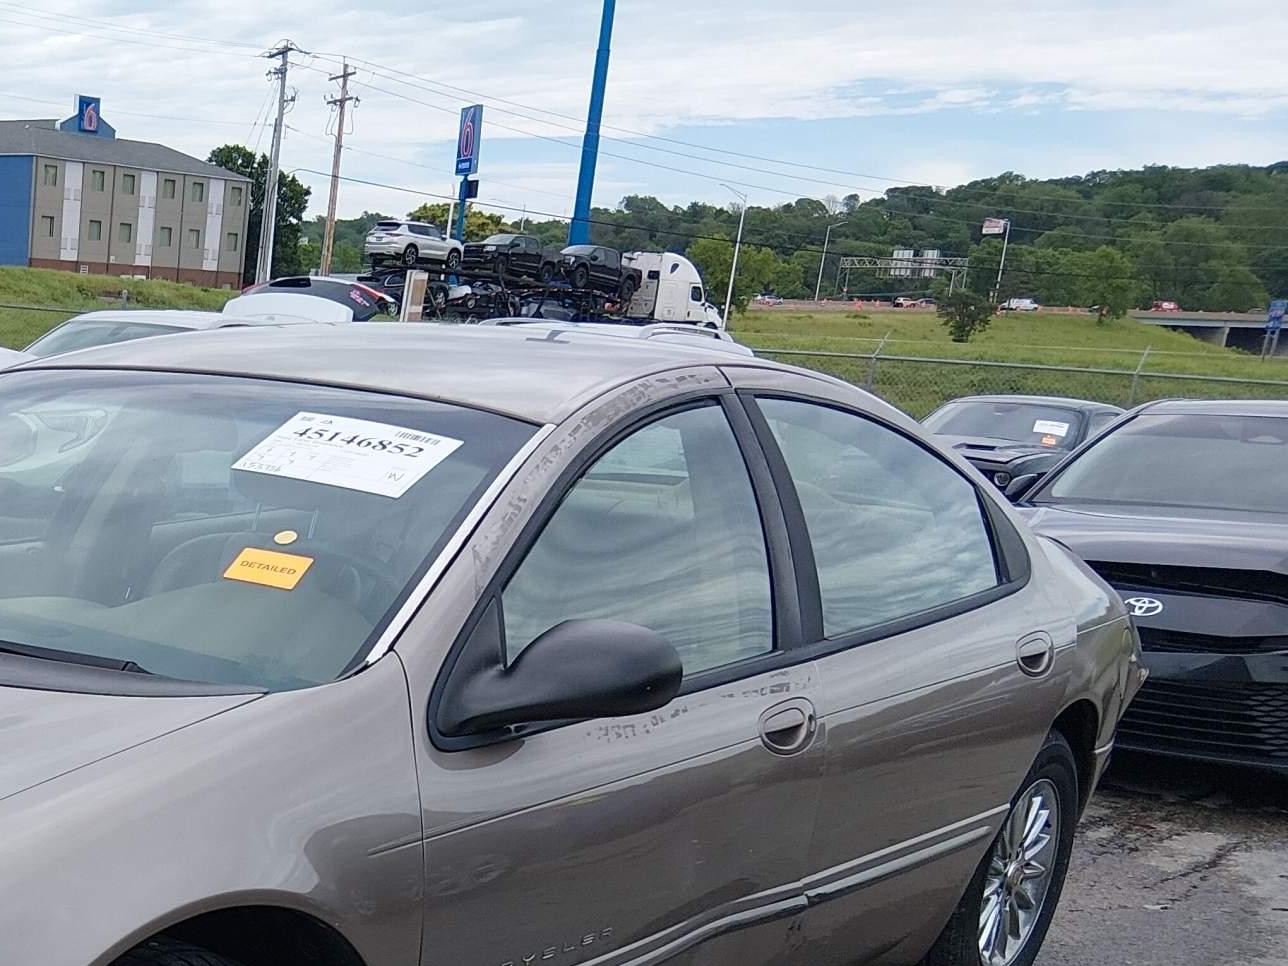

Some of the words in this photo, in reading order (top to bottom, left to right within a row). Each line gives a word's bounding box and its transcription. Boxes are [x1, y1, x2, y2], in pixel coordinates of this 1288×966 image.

[83, 103, 97, 131] 6
[460, 107, 474, 159] 6
[293, 426, 425, 459] 45146852
[240, 560, 297, 576] DETAILED
